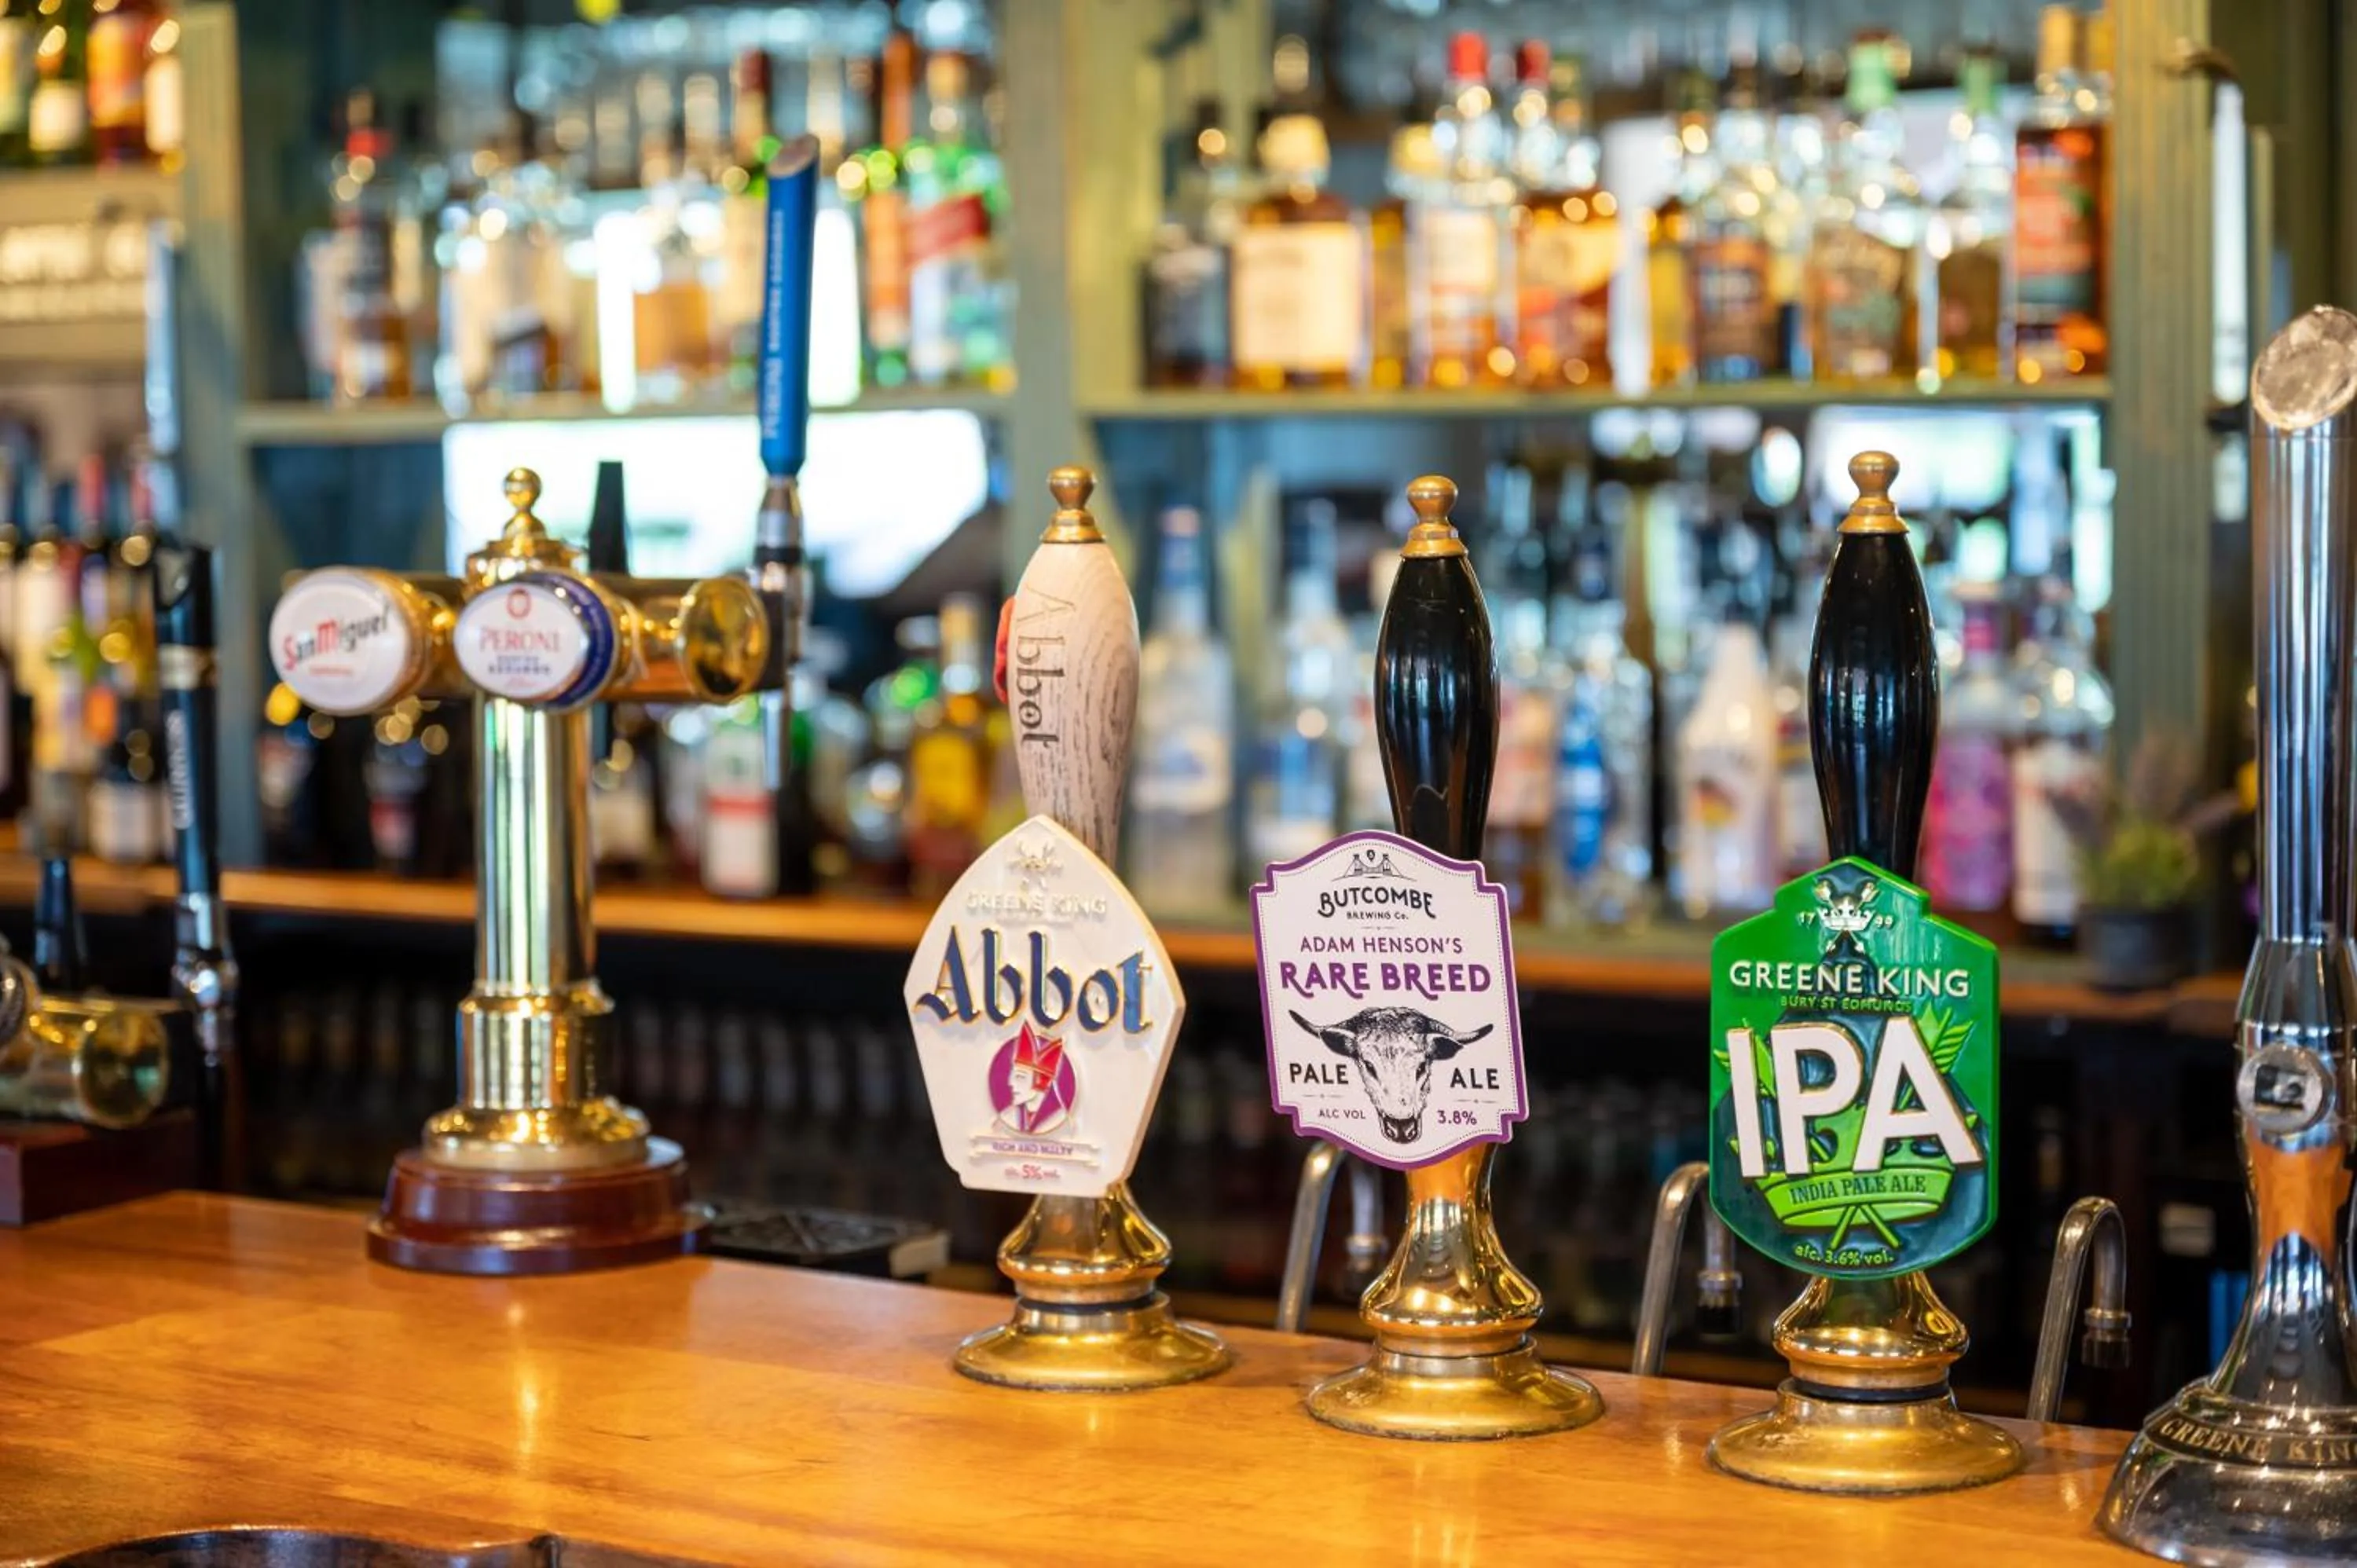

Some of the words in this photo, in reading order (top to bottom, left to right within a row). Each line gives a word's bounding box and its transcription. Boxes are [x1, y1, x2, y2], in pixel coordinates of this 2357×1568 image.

[479, 626, 561, 653] PERONI
[1017, 584, 1076, 749] Abbot
[1051, 893, 1107, 916] KING
[1318, 886, 1436, 919] BUTCOMBE
[1347, 910, 1391, 920] BREWING
[1300, 936, 1354, 952] ADAM
[1363, 937, 1463, 954] HENSON'S
[915, 925, 1153, 1035] Abbot
[1280, 962, 1370, 999] RARE
[1380, 962, 1491, 1001] BREED
[1728, 960, 1864, 994] GREENE
[1877, 966, 1970, 998] KING
[1780, 995, 1816, 1008] BURY
[1820, 996, 1838, 1009] ST
[1842, 997, 1912, 1013] EDMUNDS
[1289, 1063, 1349, 1085] PALE
[1450, 1068, 1500, 1090] ALE
[1726, 1017, 1984, 1178] IPA
[1318, 1108, 1340, 1119] ALC
[1343, 1110, 1366, 1119] VOL
[1437, 1110, 1477, 1126] 3.8%
[1790, 1179, 1838, 1205] INDIA
[1841, 1175, 1886, 1196] PALE
[1890, 1174, 1926, 1193] ALE
[1824, 1249, 1861, 1266] 3.6%
[2161, 1418, 2272, 1460] GREENE
